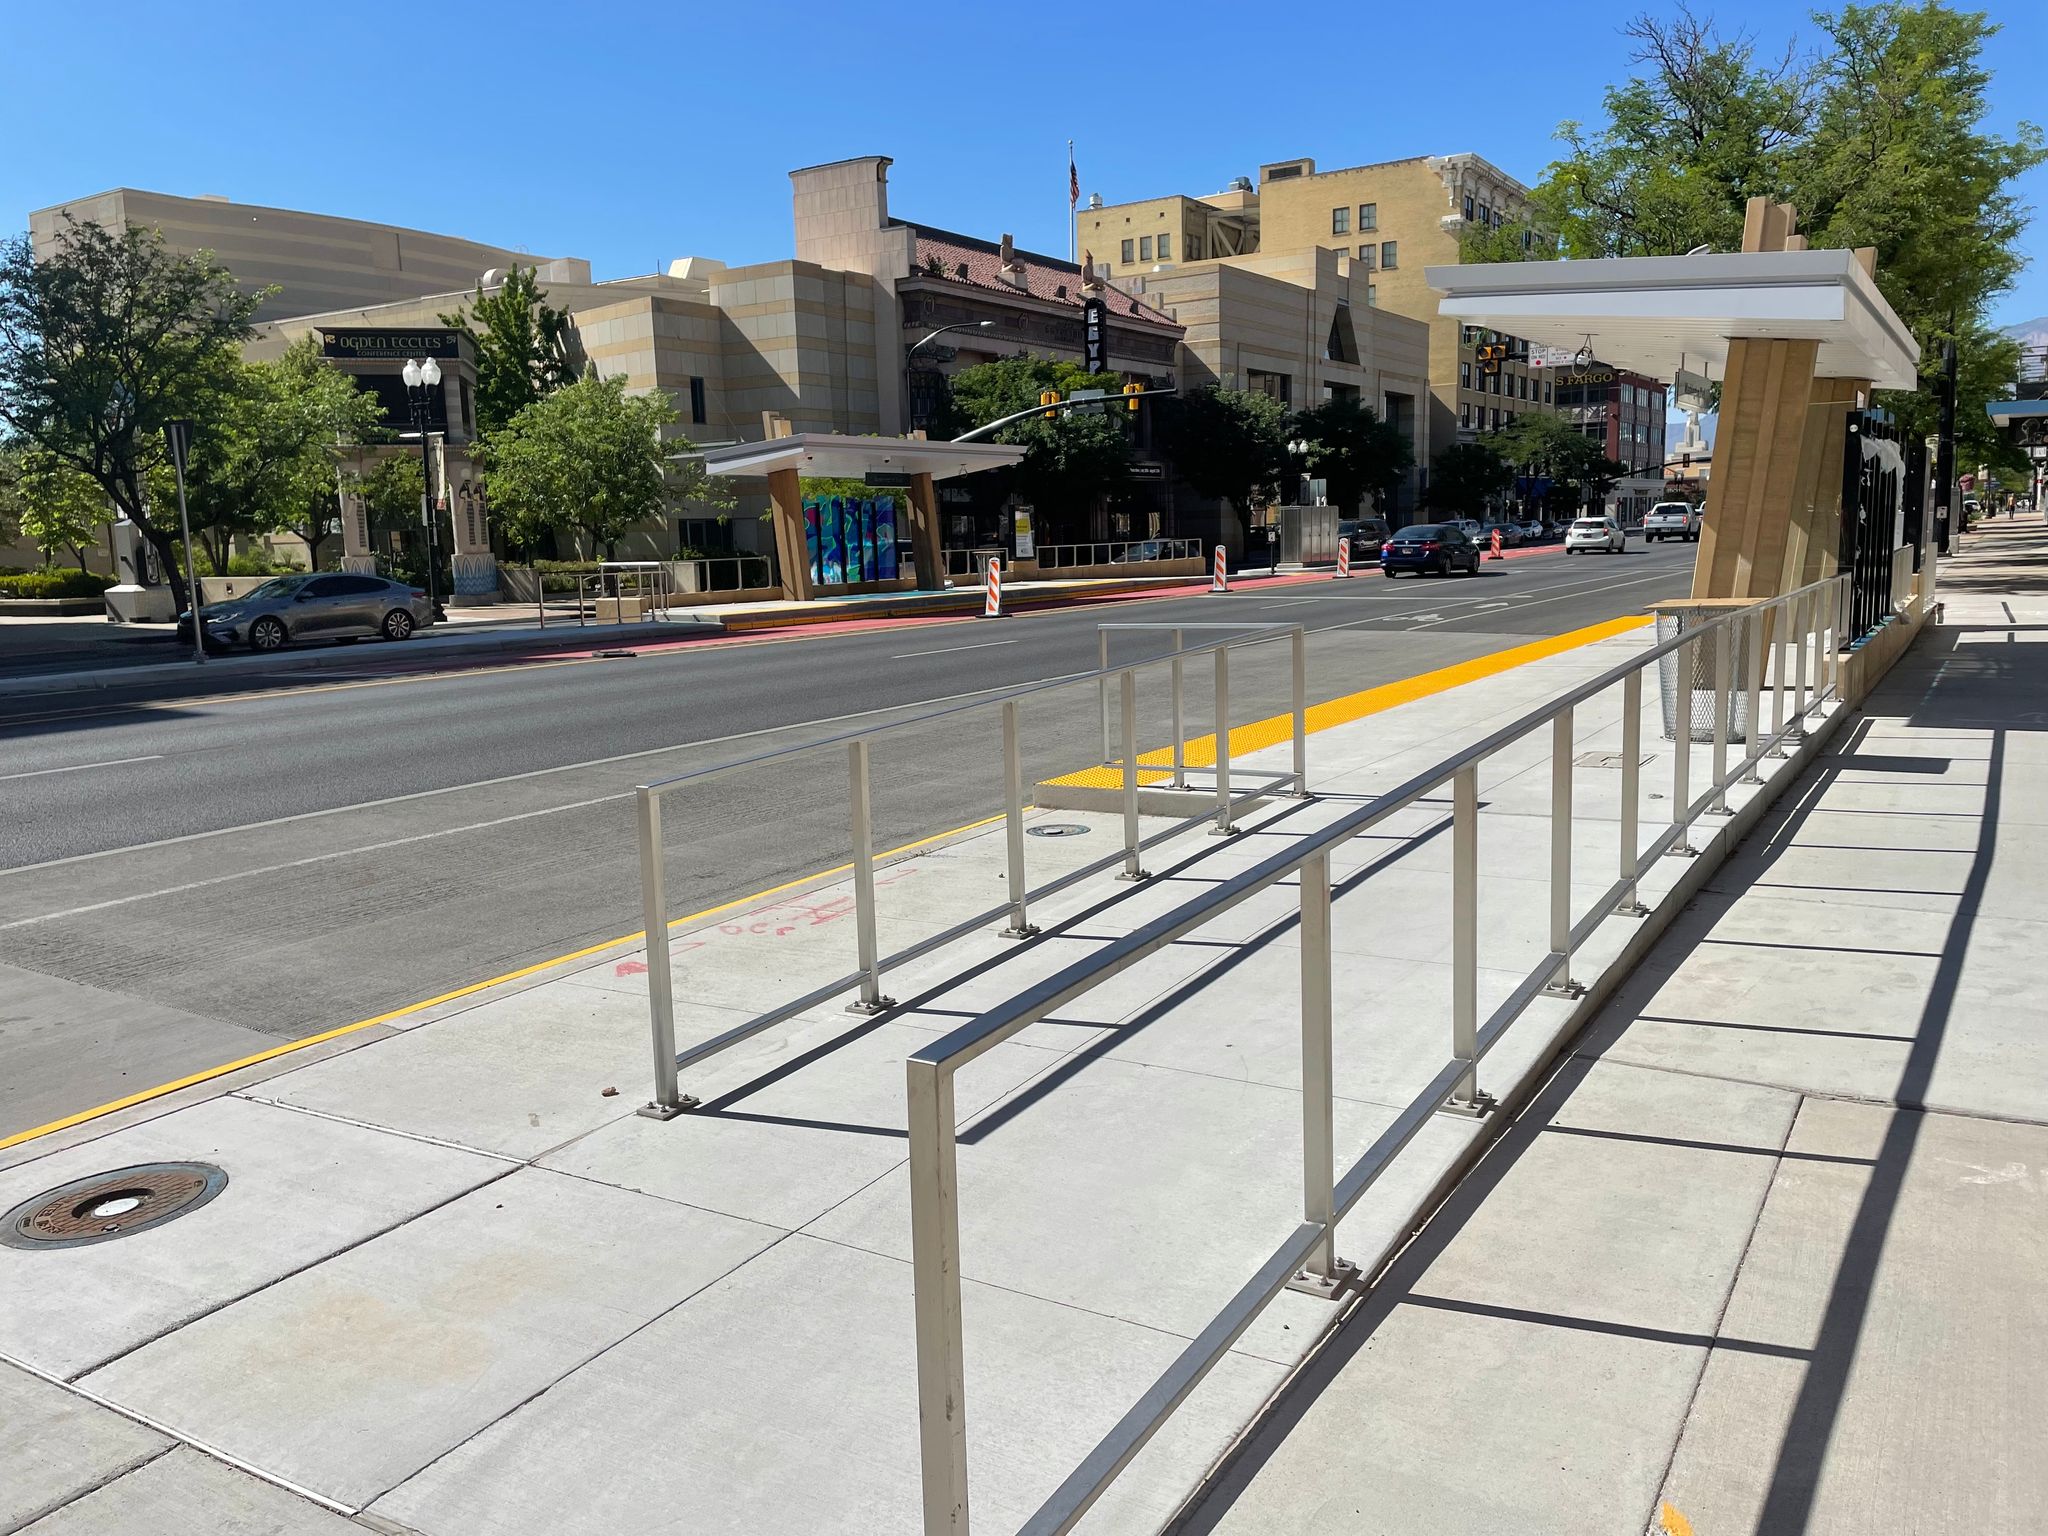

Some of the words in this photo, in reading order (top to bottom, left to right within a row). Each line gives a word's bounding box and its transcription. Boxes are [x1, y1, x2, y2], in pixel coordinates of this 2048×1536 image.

[340, 336, 386, 350] OGDEN
[391, 336, 441, 349] ECCLES
[1567, 372, 1613, 386] FARGO
